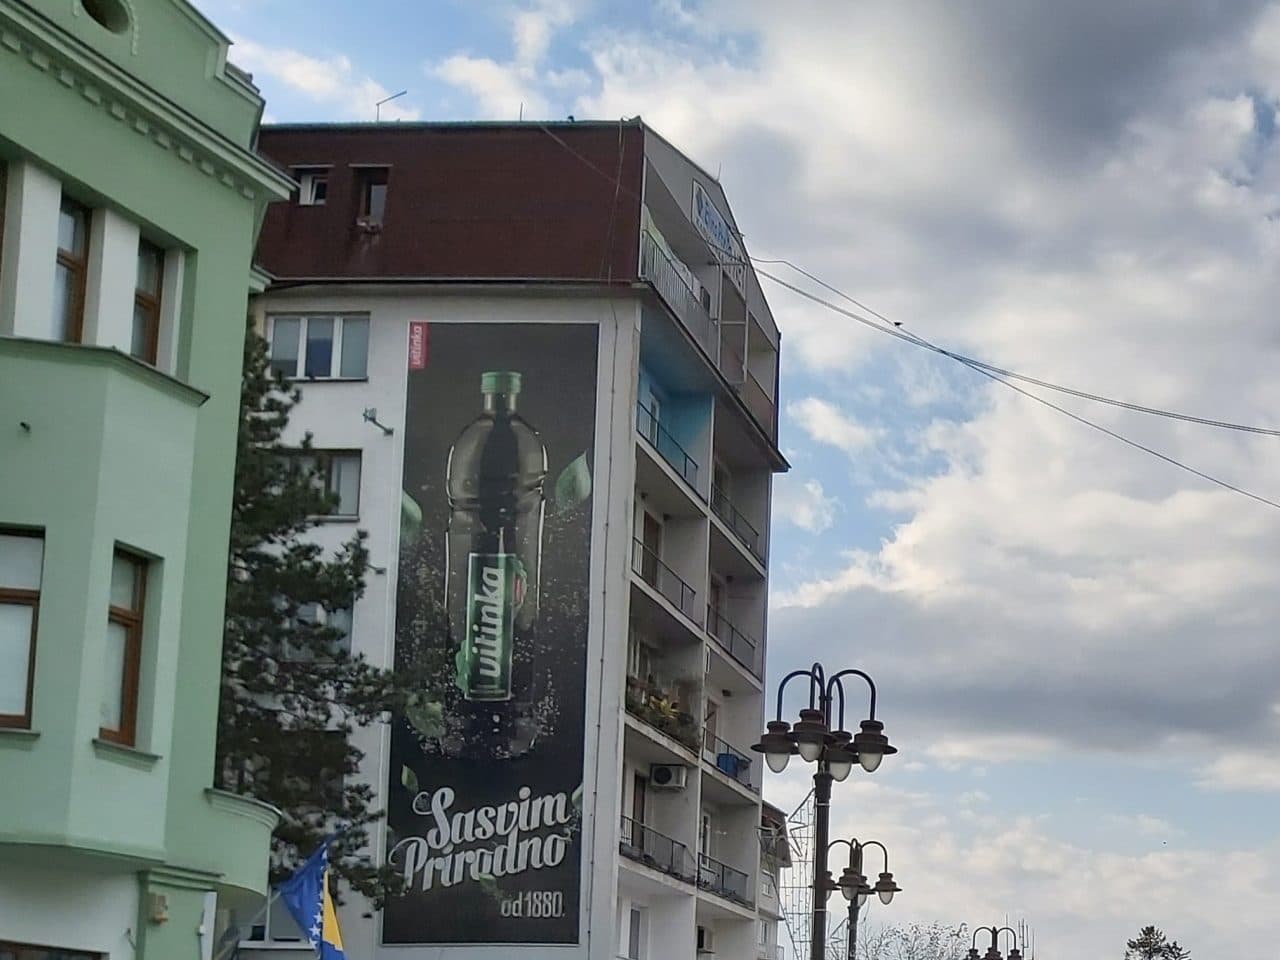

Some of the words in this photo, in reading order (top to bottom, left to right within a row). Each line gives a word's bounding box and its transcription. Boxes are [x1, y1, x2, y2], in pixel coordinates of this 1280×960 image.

[472, 567, 504, 678] vitinka
[412, 786, 572, 850] Sasvim
[389, 825, 573, 893] Prirodno
[501, 892, 523, 917] od
